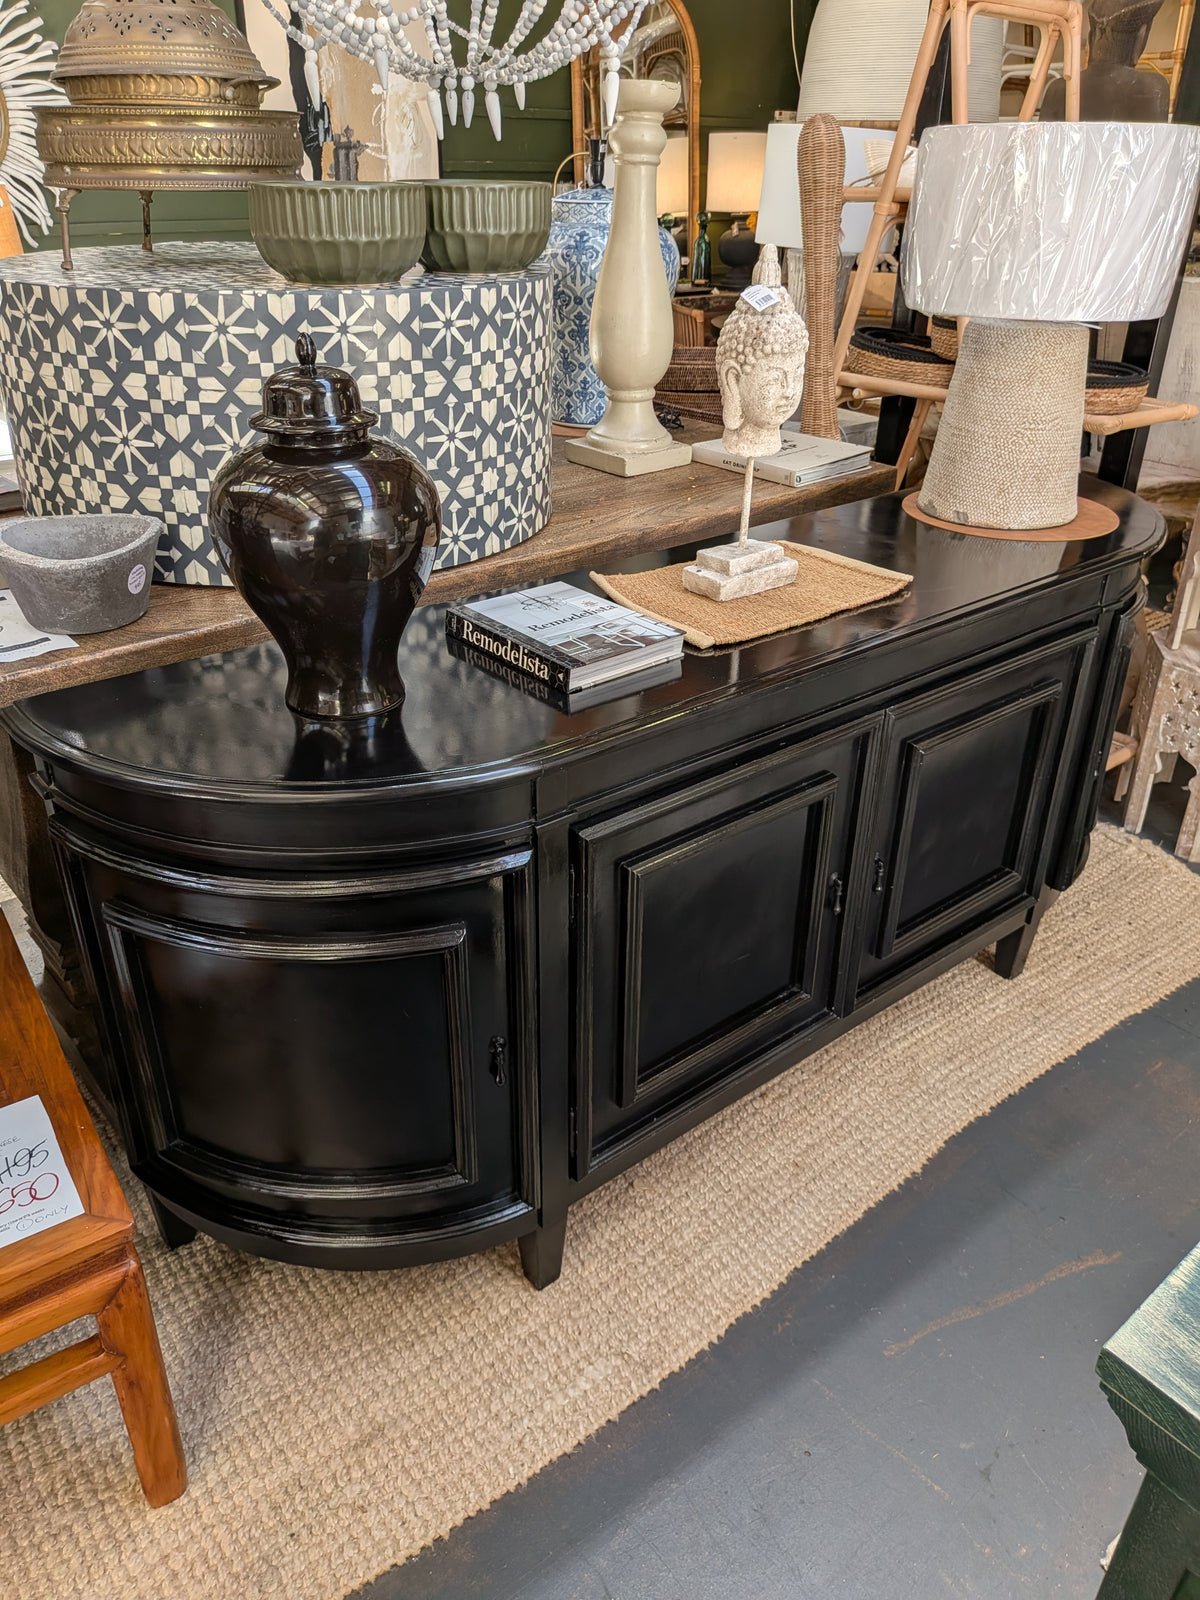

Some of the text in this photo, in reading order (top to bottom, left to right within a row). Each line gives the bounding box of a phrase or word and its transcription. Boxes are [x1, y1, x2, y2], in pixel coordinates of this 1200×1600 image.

[733, 462, 747, 470] DRIN
[528, 604, 618, 632] Remodelista
[462, 619, 549, 681] Remodelista
[35, 1205, 68, 1223] ONLY
